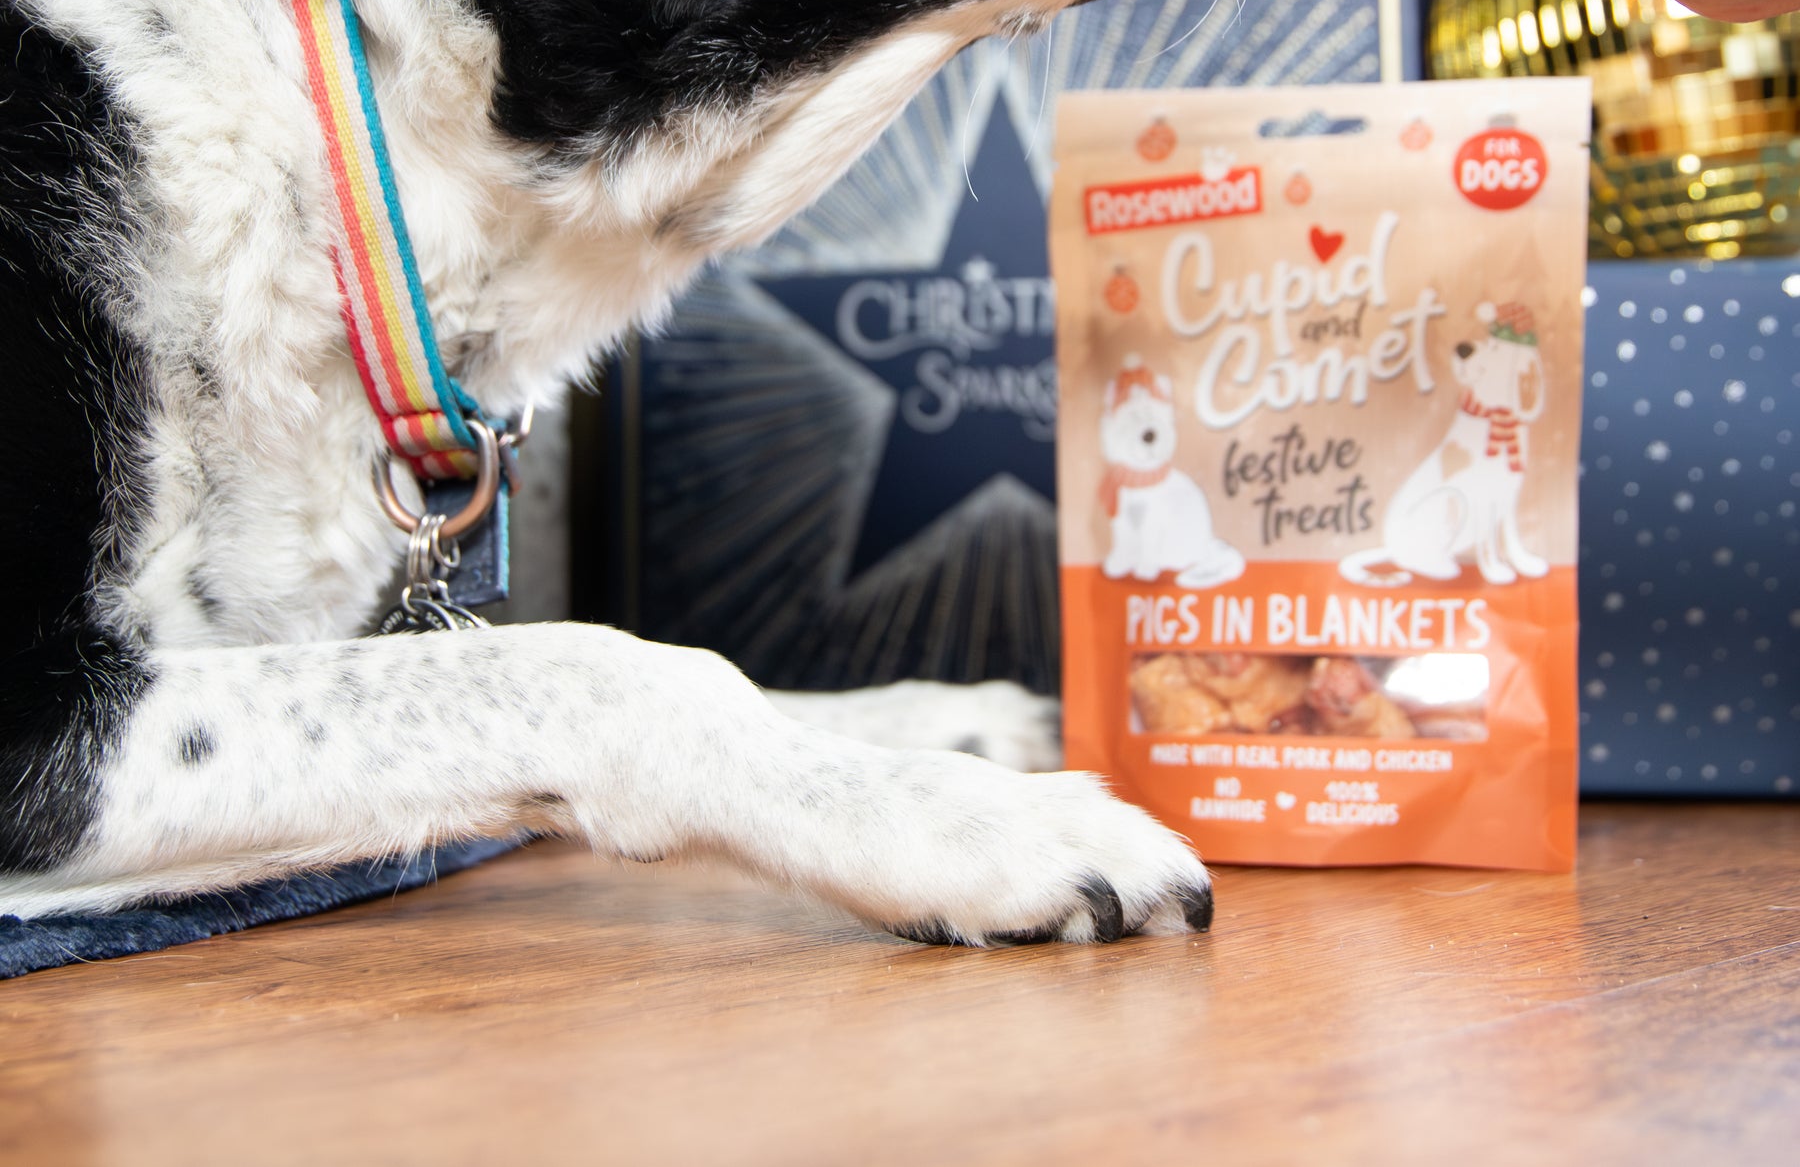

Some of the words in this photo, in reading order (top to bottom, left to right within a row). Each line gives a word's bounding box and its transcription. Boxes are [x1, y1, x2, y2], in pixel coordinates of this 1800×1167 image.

[1484, 137, 1520, 156] FOR
[1460, 158, 1539, 190] DOGS
[1088, 175, 1257, 229] Rosewood
[1161, 211, 1399, 355] Cupid
[1301, 303, 1366, 341] and
[1194, 288, 1446, 428] Comet
[1222, 424, 1363, 497] festive
[1253, 474, 1375, 545] treats
[1126, 595, 1200, 644] PIGS
[1212, 595, 1253, 644] IN
[1268, 594, 1490, 649] BLANKETS
[1150, 744, 1189, 765] MADE
[1191, 745, 1233, 766] WITH
[1235, 746, 1279, 768] REAL
[1282, 747, 1331, 770] PORK
[1333, 749, 1372, 770] AND
[1374, 750, 1453, 771] CHICKEN
[1214, 777, 1240, 798] NO
[1325, 781, 1379, 802] 100%
[1190, 797, 1267, 821] RAWHIDE
[1306, 801, 1399, 825] DELICIOUS
